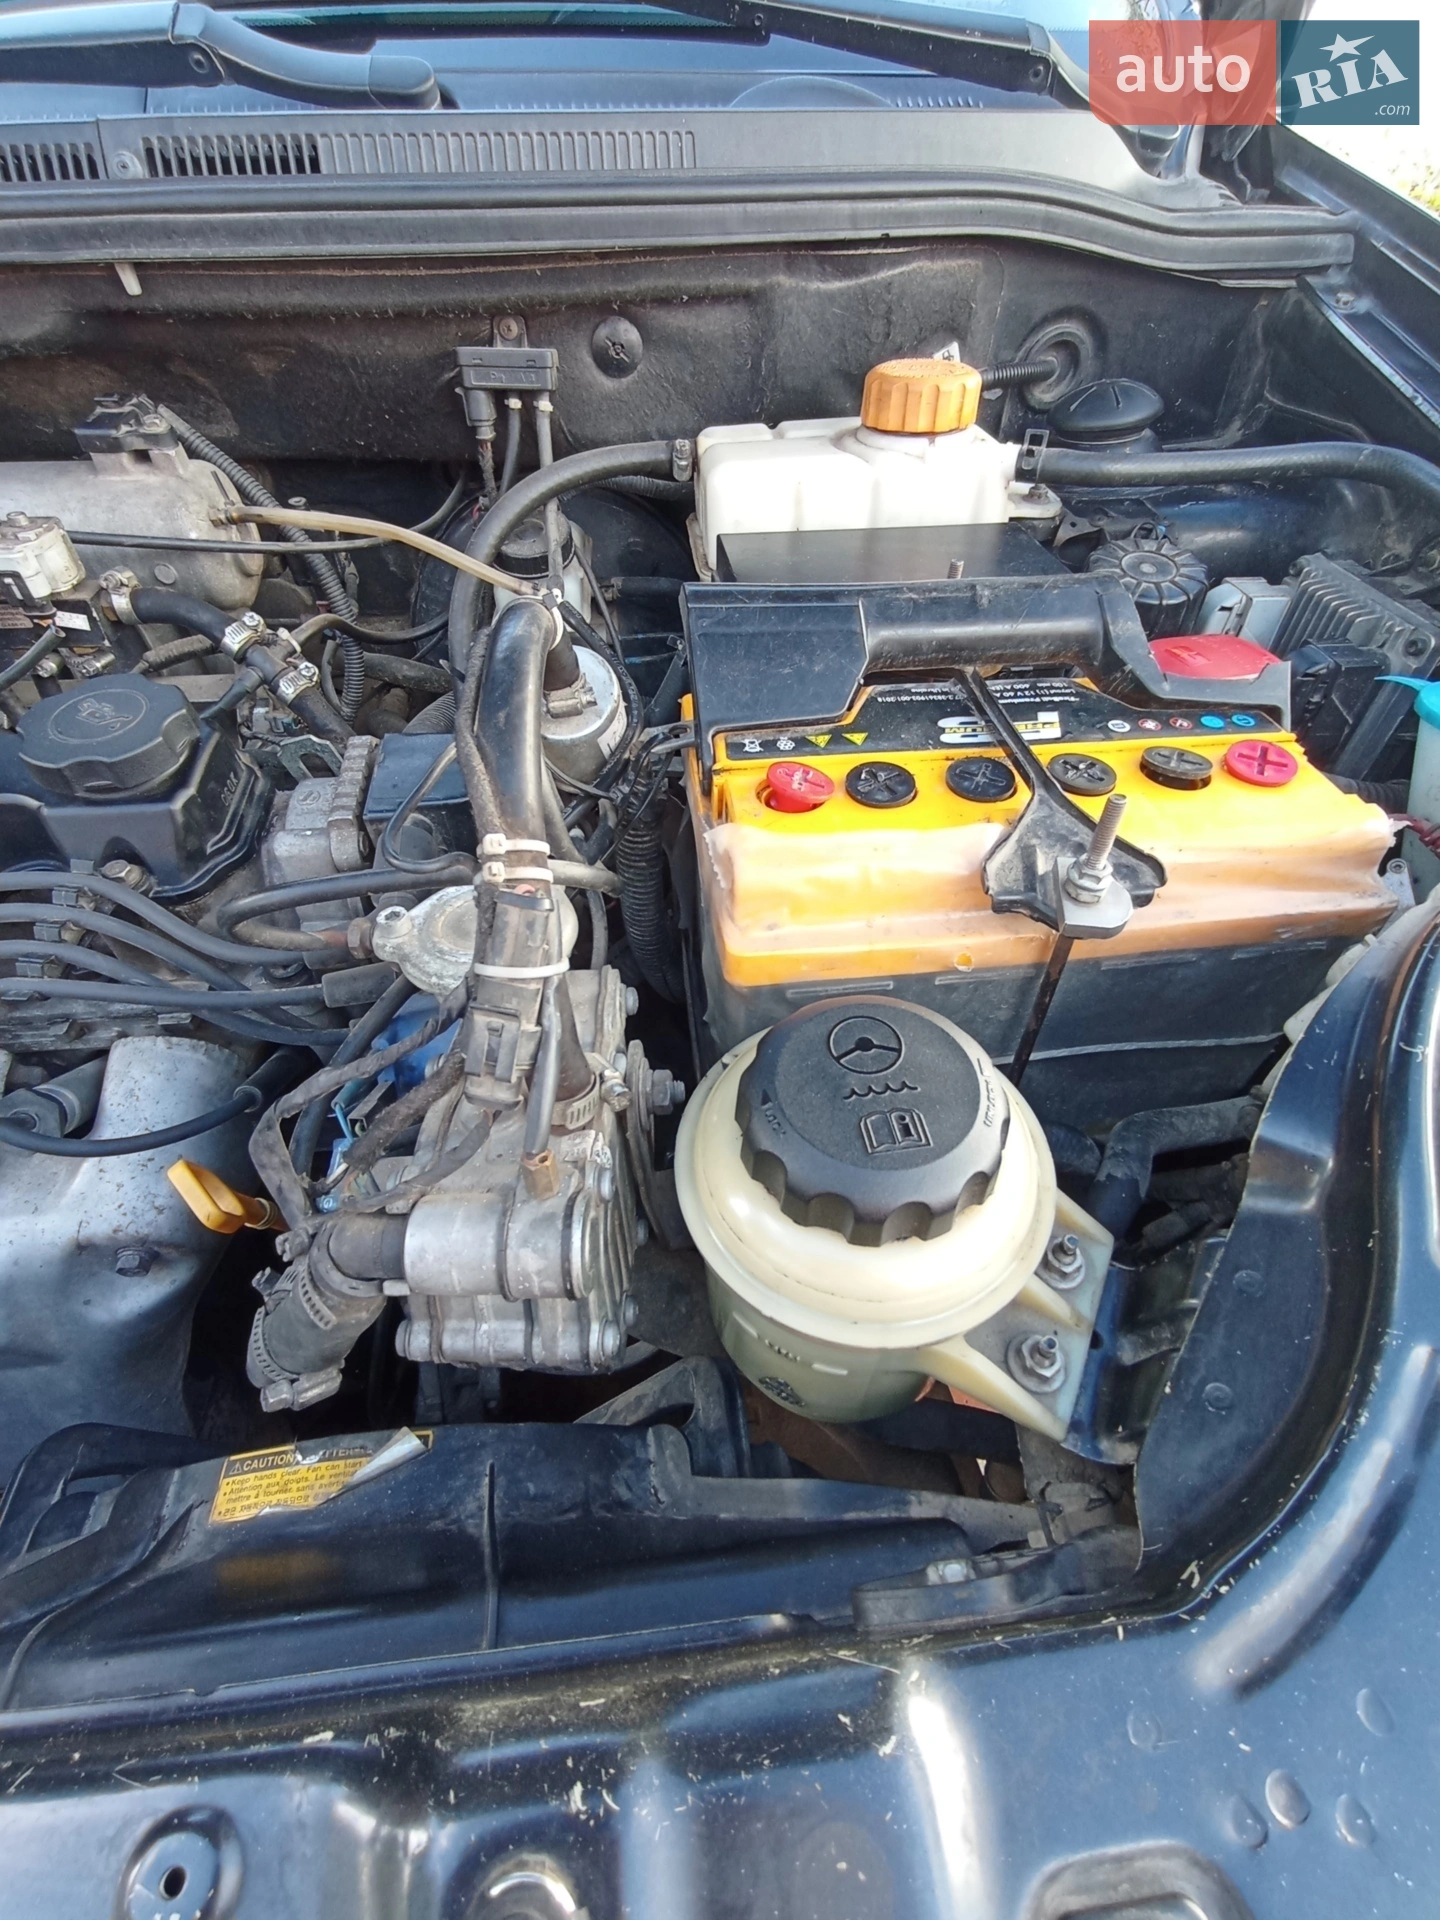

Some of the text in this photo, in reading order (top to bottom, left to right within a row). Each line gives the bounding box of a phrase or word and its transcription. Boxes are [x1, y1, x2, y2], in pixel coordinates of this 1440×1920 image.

[243, 1453, 295, 1471] CAUTION
[231, 1477, 251, 1486] Keep
[254, 1472, 277, 1482] hands
[306, 1465, 322, 1473] Fan
[325, 1463, 340, 1471] can
[266, 1481, 280, 1489] aux
[315, 1473, 326, 1481] Le
[226, 1494, 251, 1504] mettre
[296, 1484, 315, 1493] sans
